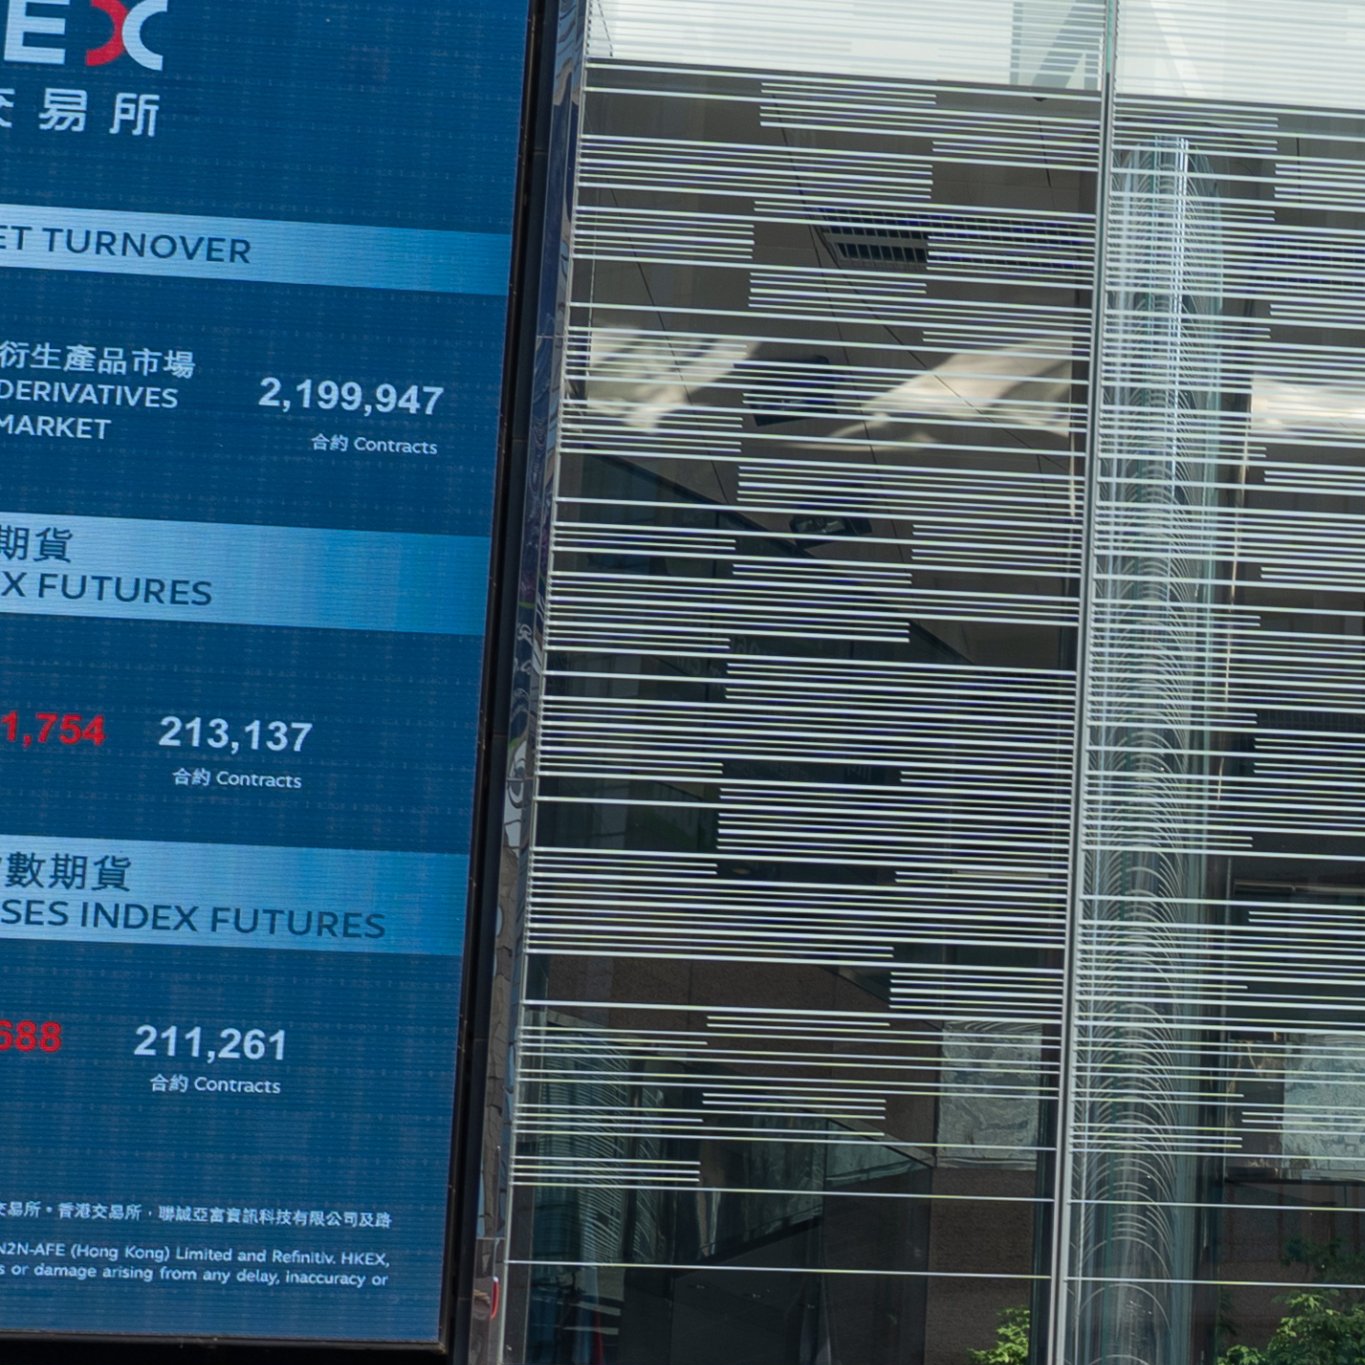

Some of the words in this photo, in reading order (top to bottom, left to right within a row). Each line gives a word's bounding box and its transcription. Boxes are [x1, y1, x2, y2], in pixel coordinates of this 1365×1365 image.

[42, 227, 251, 264] TURNOVER
[0, 340, 196, 379] 衍生產品市場
[0, 379, 179, 408] DERIVATIVES
[258, 376, 444, 416] 2,199,947
[0, 414, 112, 440] MARKET
[312, 433, 348, 452] 合約
[353, 436, 438, 456] Contracts
[38, 573, 213, 607] FUTURES
[158, 716, 313, 754] 213,137
[173, 767, 210, 786] 合約
[216, 770, 303, 789] Contracts
[81, 902, 198, 932] INDEX
[210, 907, 387, 939] FUTURES
[133, 1023, 286, 1063] 211,261
[150, 1074, 188, 1093] 合約
[194, 1076, 281, 1095] Contracts
[71, 1243, 118, 1262] (Hong
[124, 1245, 170, 1264] Kong)
[176, 1246, 232, 1263] Limited
[237, 1248, 266, 1263] and
[341, 1251, 391, 1268] HKEX,
[11, 1264, 30, 1276] or
[34, 1262, 97, 1280] damage
[102, 1265, 153, 1282] arising
[160, 1265, 197, 1281] from
[202, 1269, 230, 1285] any
[236, 1267, 280, 1286] delay,
[285, 1270, 366, 1289] inaccuracy
[371, 1274, 389, 1287] or
